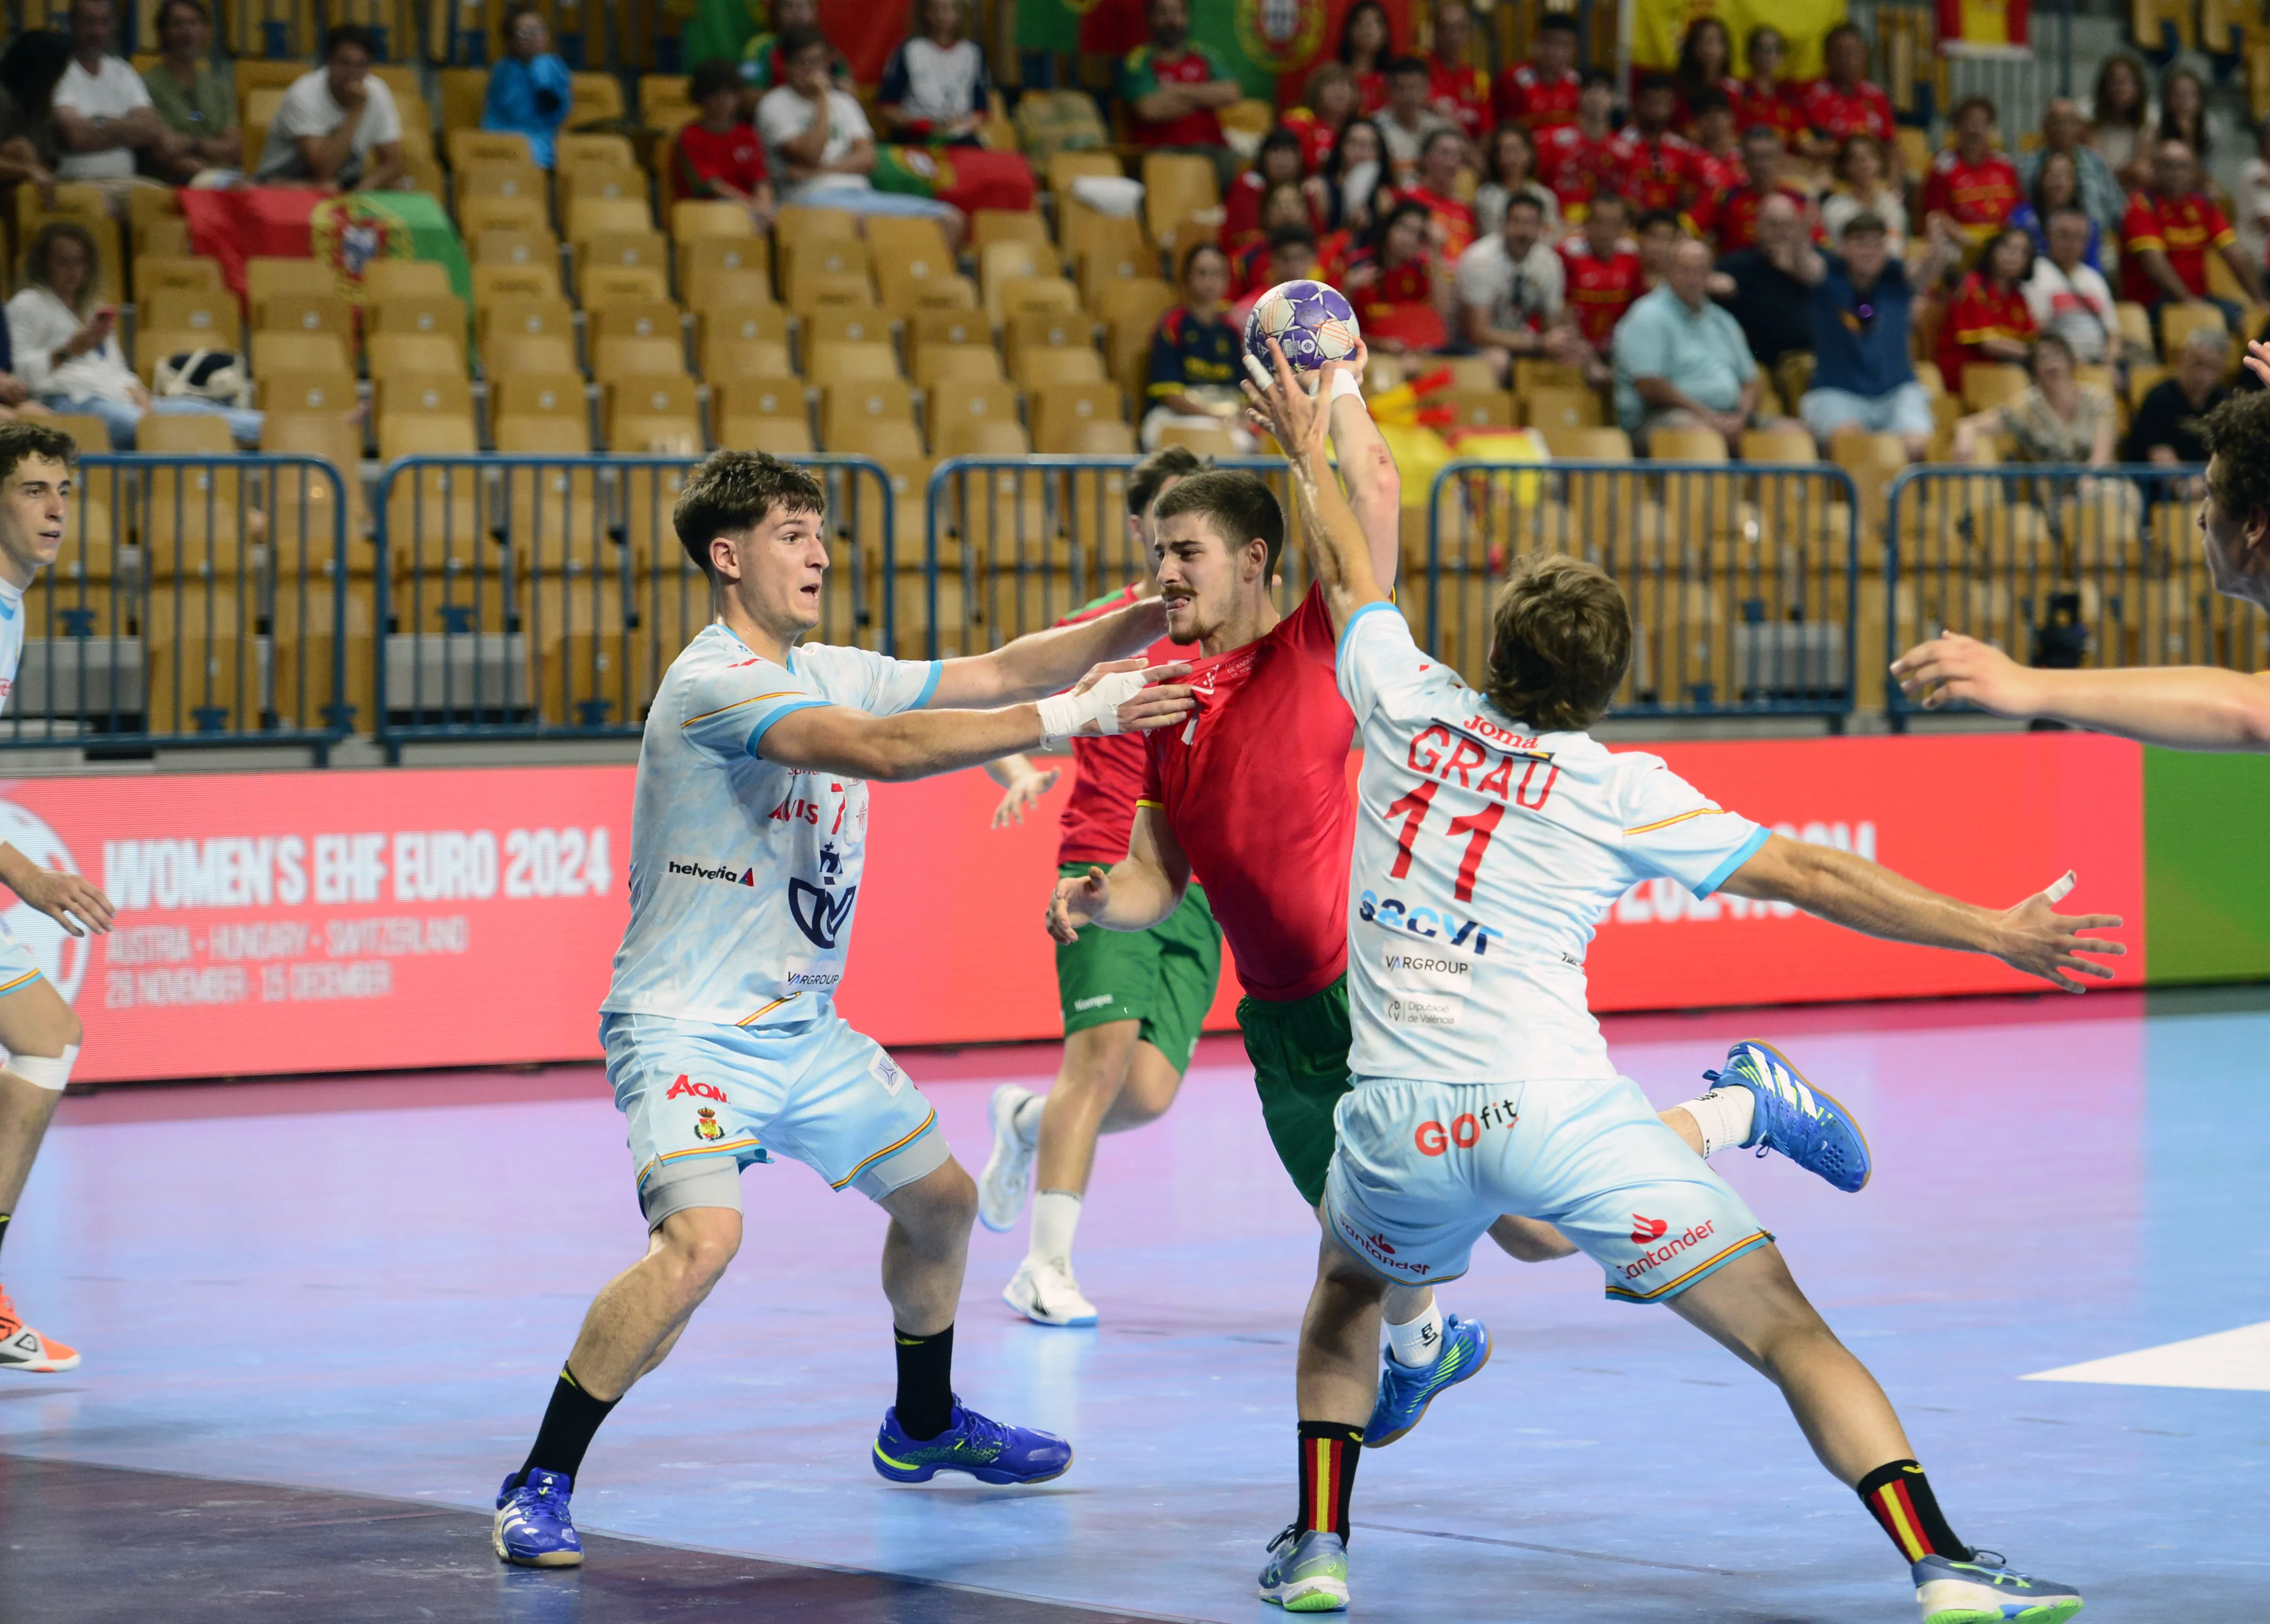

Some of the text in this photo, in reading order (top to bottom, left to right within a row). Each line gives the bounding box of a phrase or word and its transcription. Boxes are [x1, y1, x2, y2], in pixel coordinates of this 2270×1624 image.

[1464, 715, 1538, 749] Joma
[1408, 725, 1559, 811] GRAU
[768, 799, 819, 825] AVIS
[1384, 780, 1505, 903] 11
[104, 827, 613, 910] WOMEN'S EHF EURO 2024
[210, 921, 310, 961] HUNGARY
[138, 966, 247, 1005] NOVEMBER
[289, 960, 393, 1000] DECEMBER
[1408, 1001, 1449, 1013] Diputació
[1408, 1014, 1418, 1023] de
[1420, 1013, 1454, 1024] València
